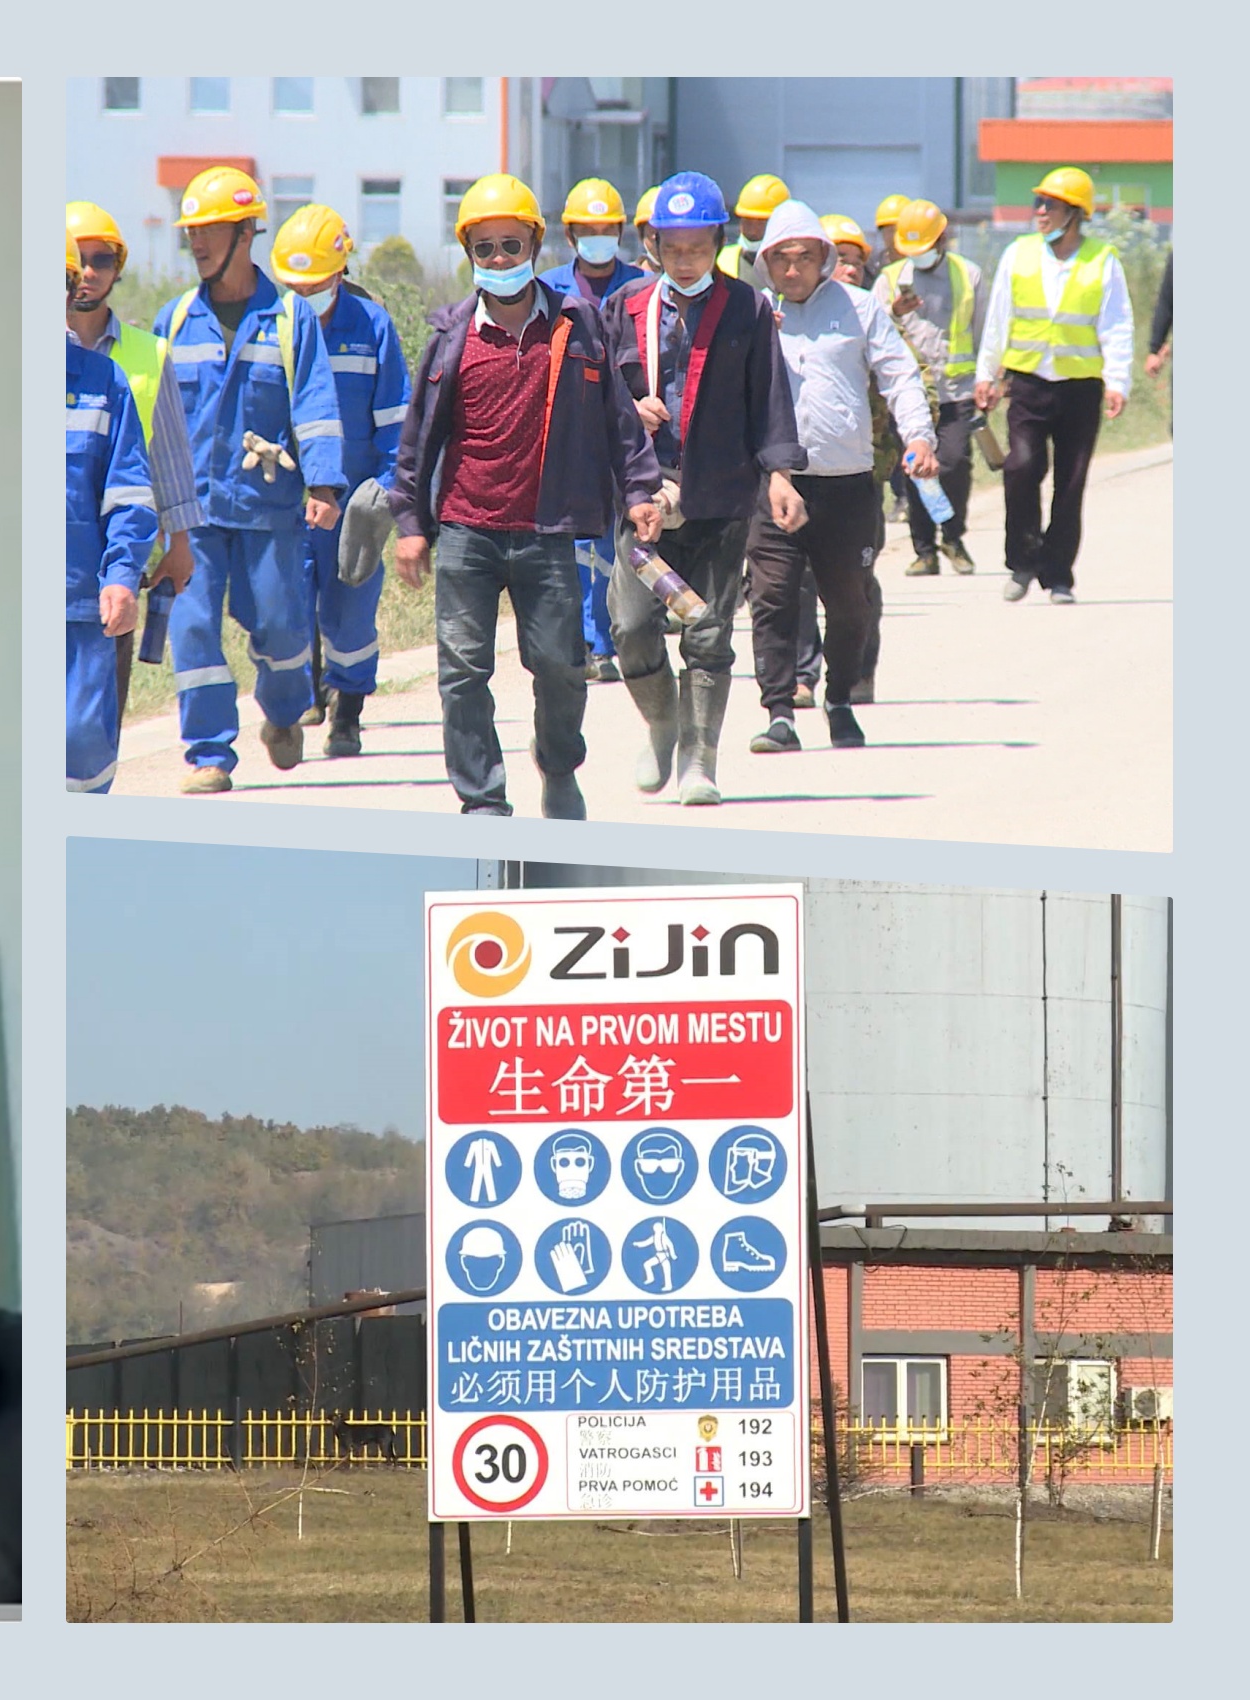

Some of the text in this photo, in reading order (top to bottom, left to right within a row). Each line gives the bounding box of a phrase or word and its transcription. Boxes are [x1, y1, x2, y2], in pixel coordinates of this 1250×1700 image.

[448, 1010, 783, 1049] ŽIVOT NA PRVOM MESTU
[487, 1052, 742, 1118] 生命第一
[487, 1304, 745, 1332] OBAVEZNA UPOTREBA
[448, 1333, 786, 1364] LIČNIH ZAŠTITNIH SREDSTAVA
[450, 1366, 782, 1406] 必须用个人防护用品
[578, 1415, 647, 1429] POLICIJA
[738, 1418, 773, 1436] 192
[473, 1442, 527, 1485] 30
[579, 1446, 678, 1460] VATROGASCI
[738, 1450, 773, 1467] 193
[578, 1477, 679, 1492] PRVA POMOĆ
[738, 1481, 774, 1499] 194
